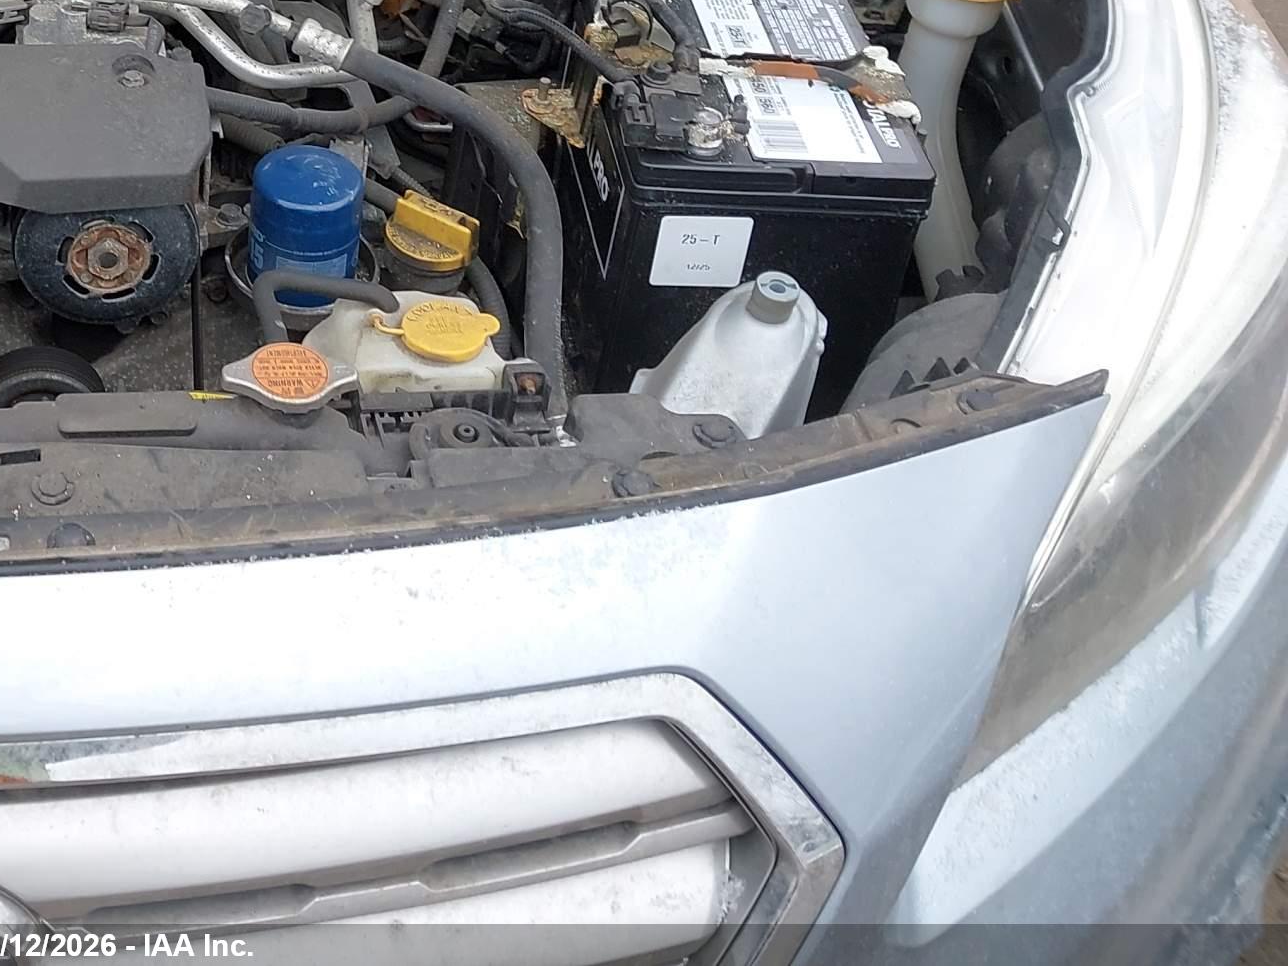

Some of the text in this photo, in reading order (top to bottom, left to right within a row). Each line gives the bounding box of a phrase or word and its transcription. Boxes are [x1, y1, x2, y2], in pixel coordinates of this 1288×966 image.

[728, 26, 748, 45] 25-T
[759, 98, 776, 114] 560
[267, 378, 303, 387] WARNING
